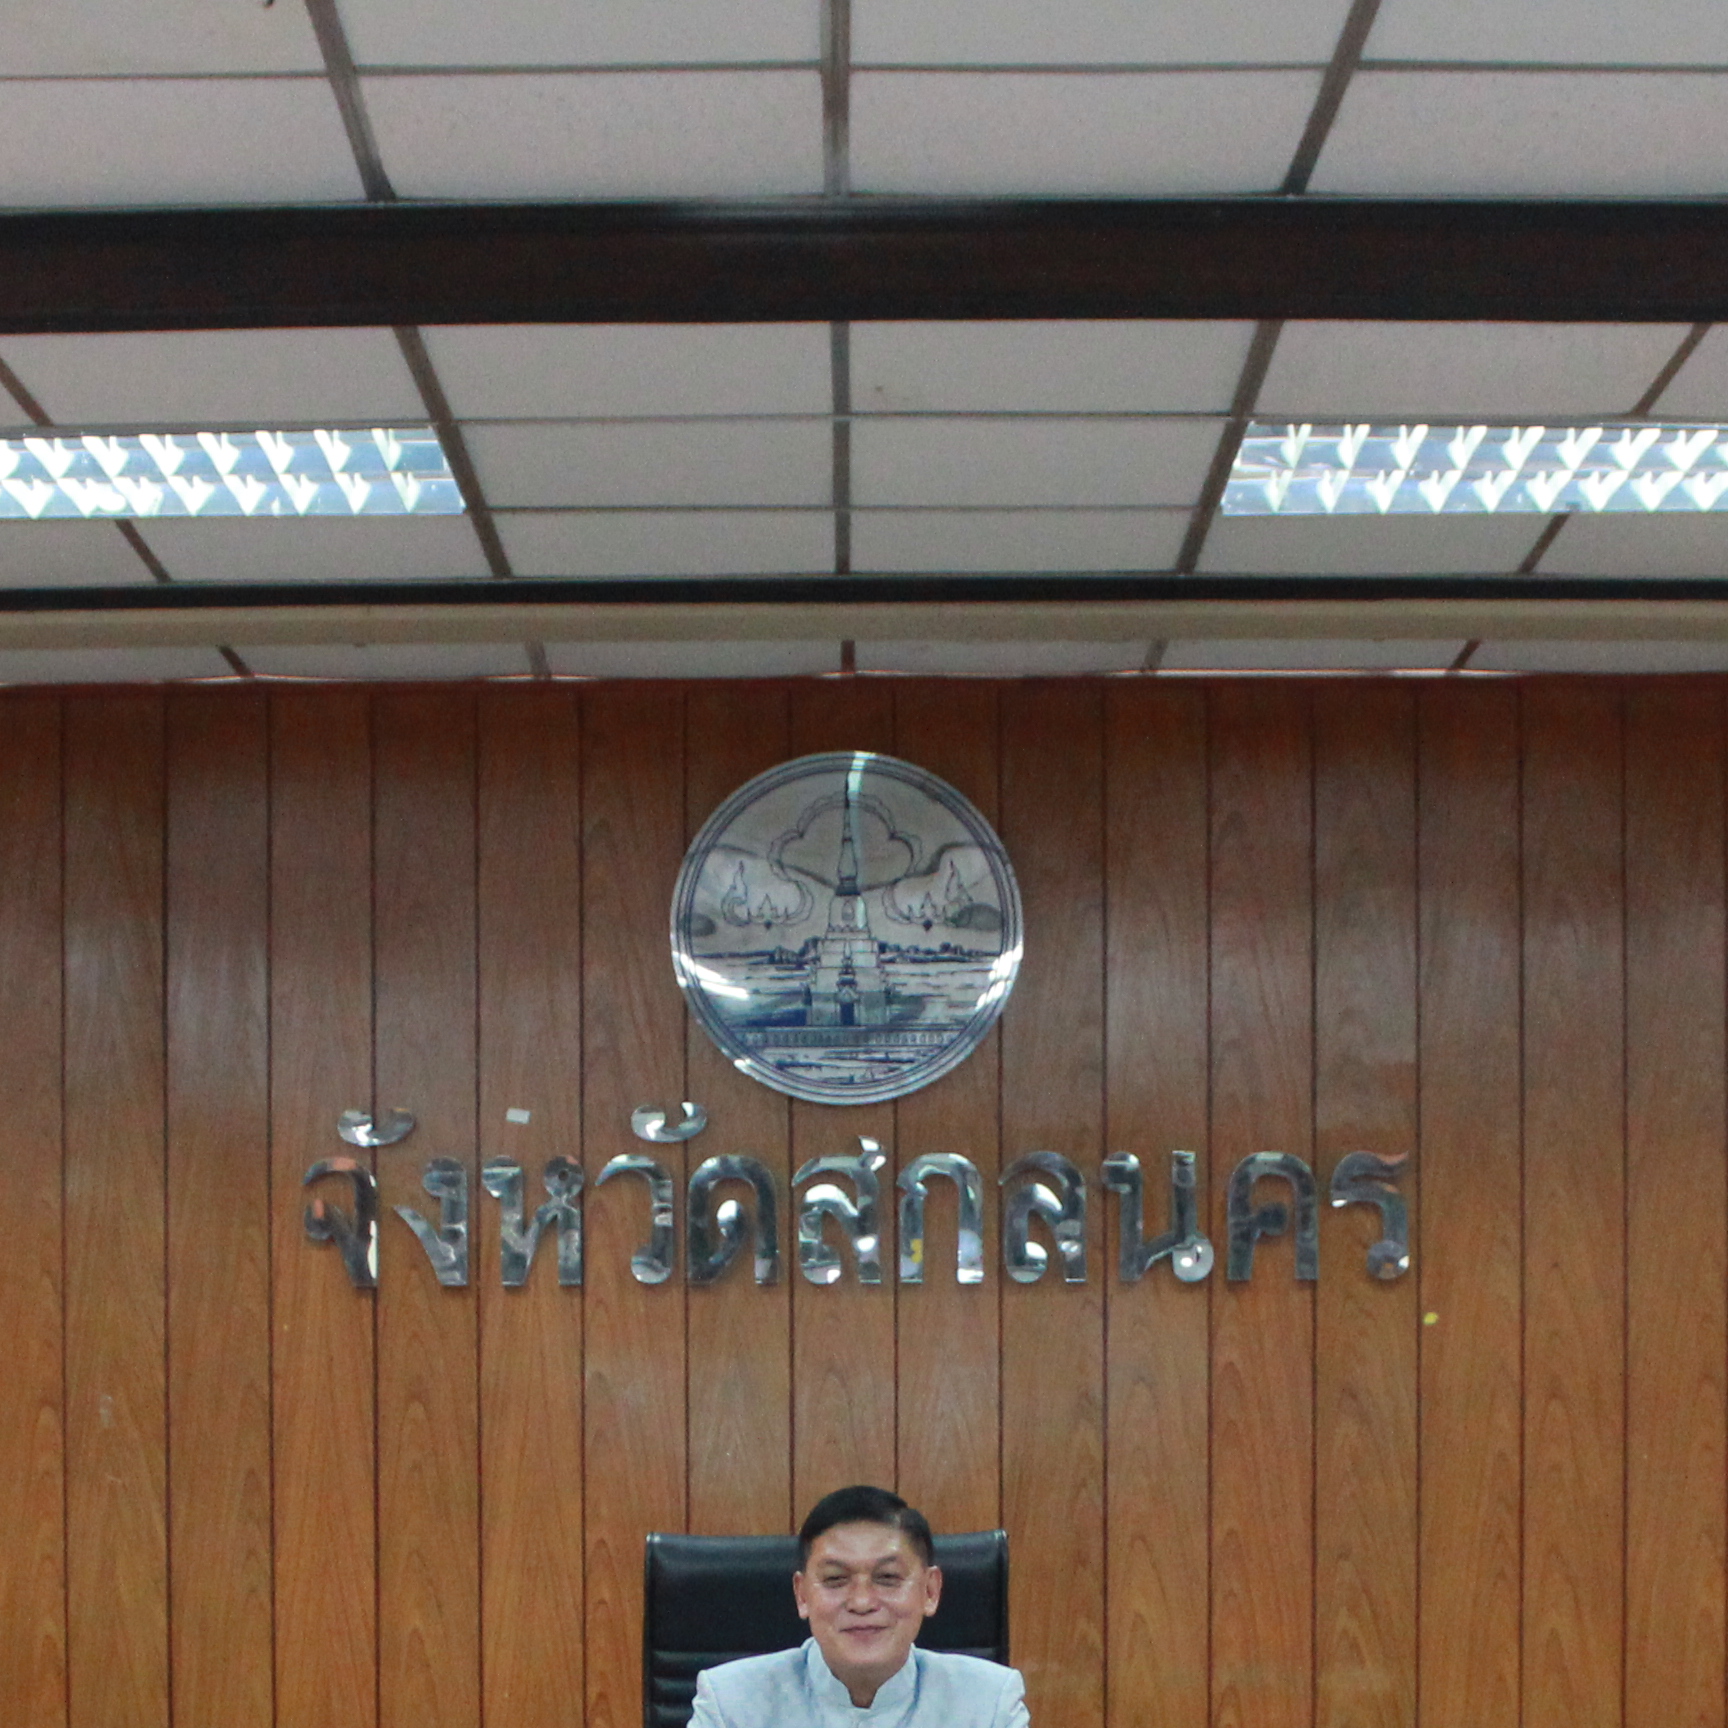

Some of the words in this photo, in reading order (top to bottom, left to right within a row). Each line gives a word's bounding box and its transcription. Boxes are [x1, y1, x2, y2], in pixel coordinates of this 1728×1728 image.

[300, 1101, 1411, 1287] จังหวัดสกลนคร
